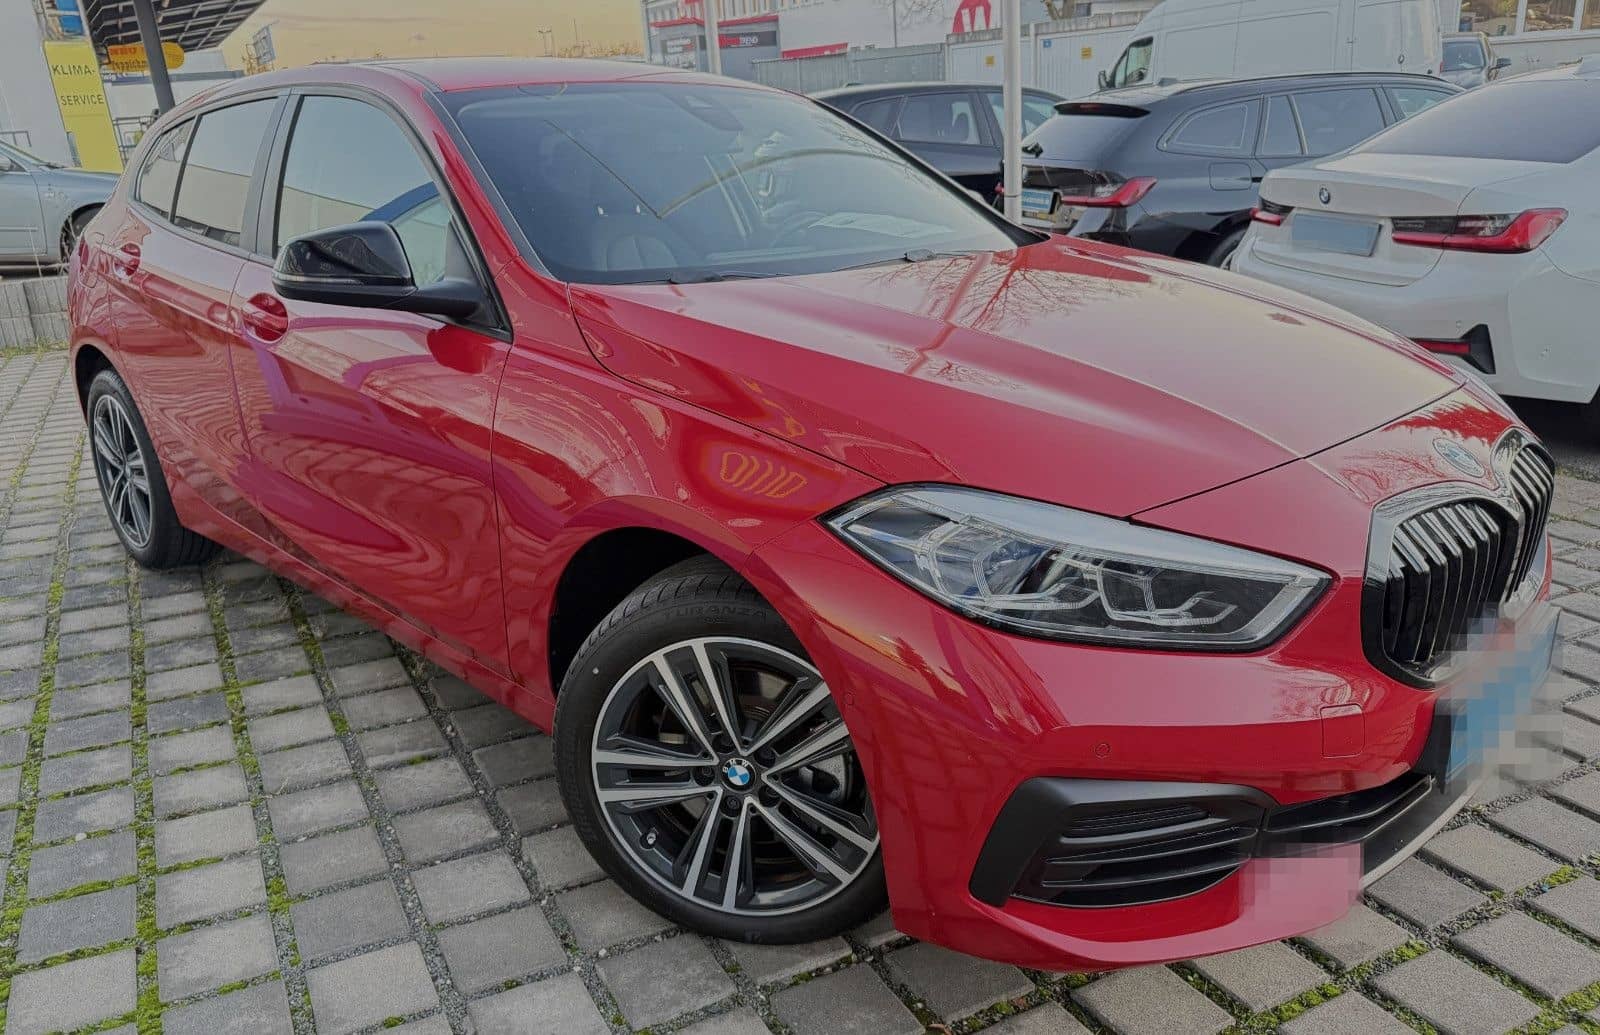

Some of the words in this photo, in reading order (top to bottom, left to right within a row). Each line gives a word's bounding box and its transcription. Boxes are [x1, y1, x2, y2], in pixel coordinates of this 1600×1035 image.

[51, 64, 96, 75] KLIMA-
[60, 94, 104, 106] SERVICE
[722, 757, 749, 773] BMW
